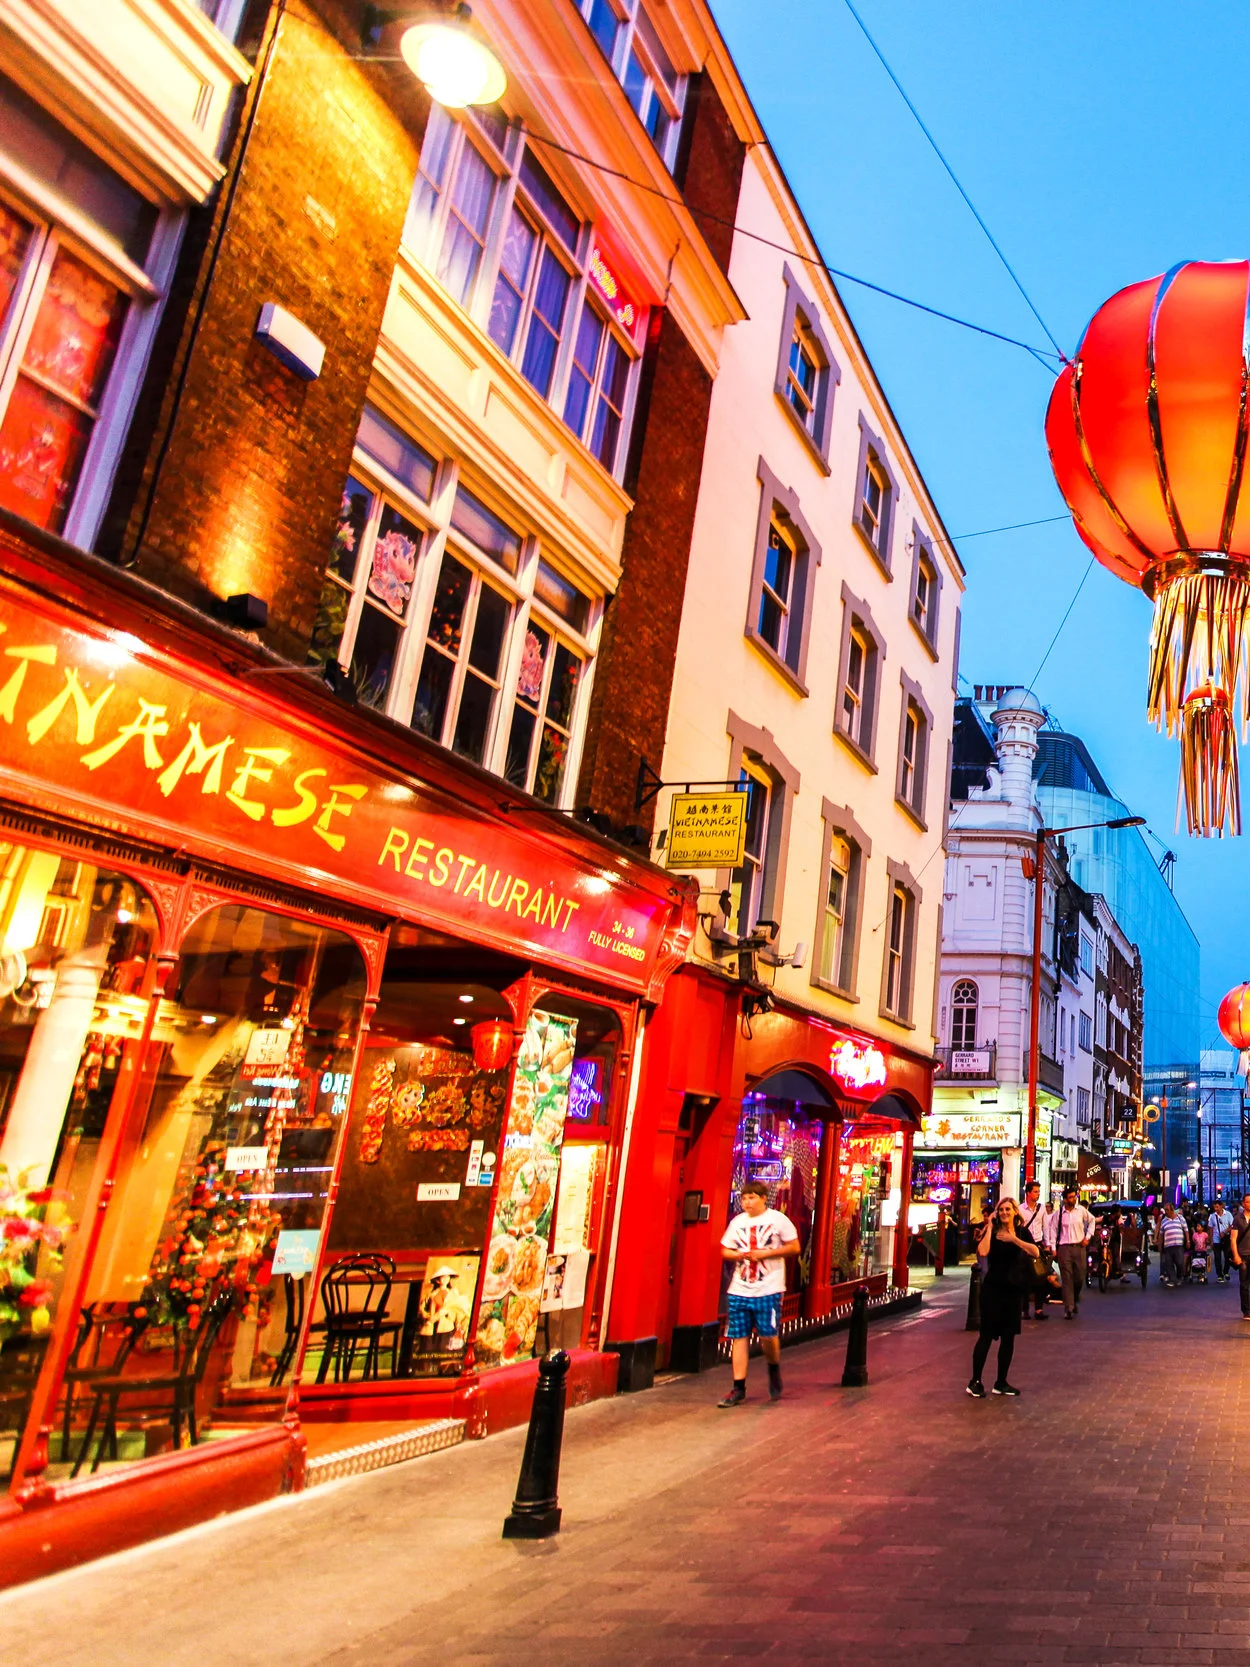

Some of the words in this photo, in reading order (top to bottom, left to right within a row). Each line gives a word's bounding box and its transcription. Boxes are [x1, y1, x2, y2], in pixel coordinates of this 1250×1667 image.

[0, 622, 368, 852] TNAMESE
[378, 827, 579, 933] RESTAURANT
[676, 816, 738, 827] VIETNAMESE
[674, 830, 736, 838] RESTAURANT
[672, 850, 711, 859] 020-7494
[588, 930, 612, 949] FULLY
[612, 940, 645, 961] LICENSED
[236, 1155, 258, 1163] OPEN
